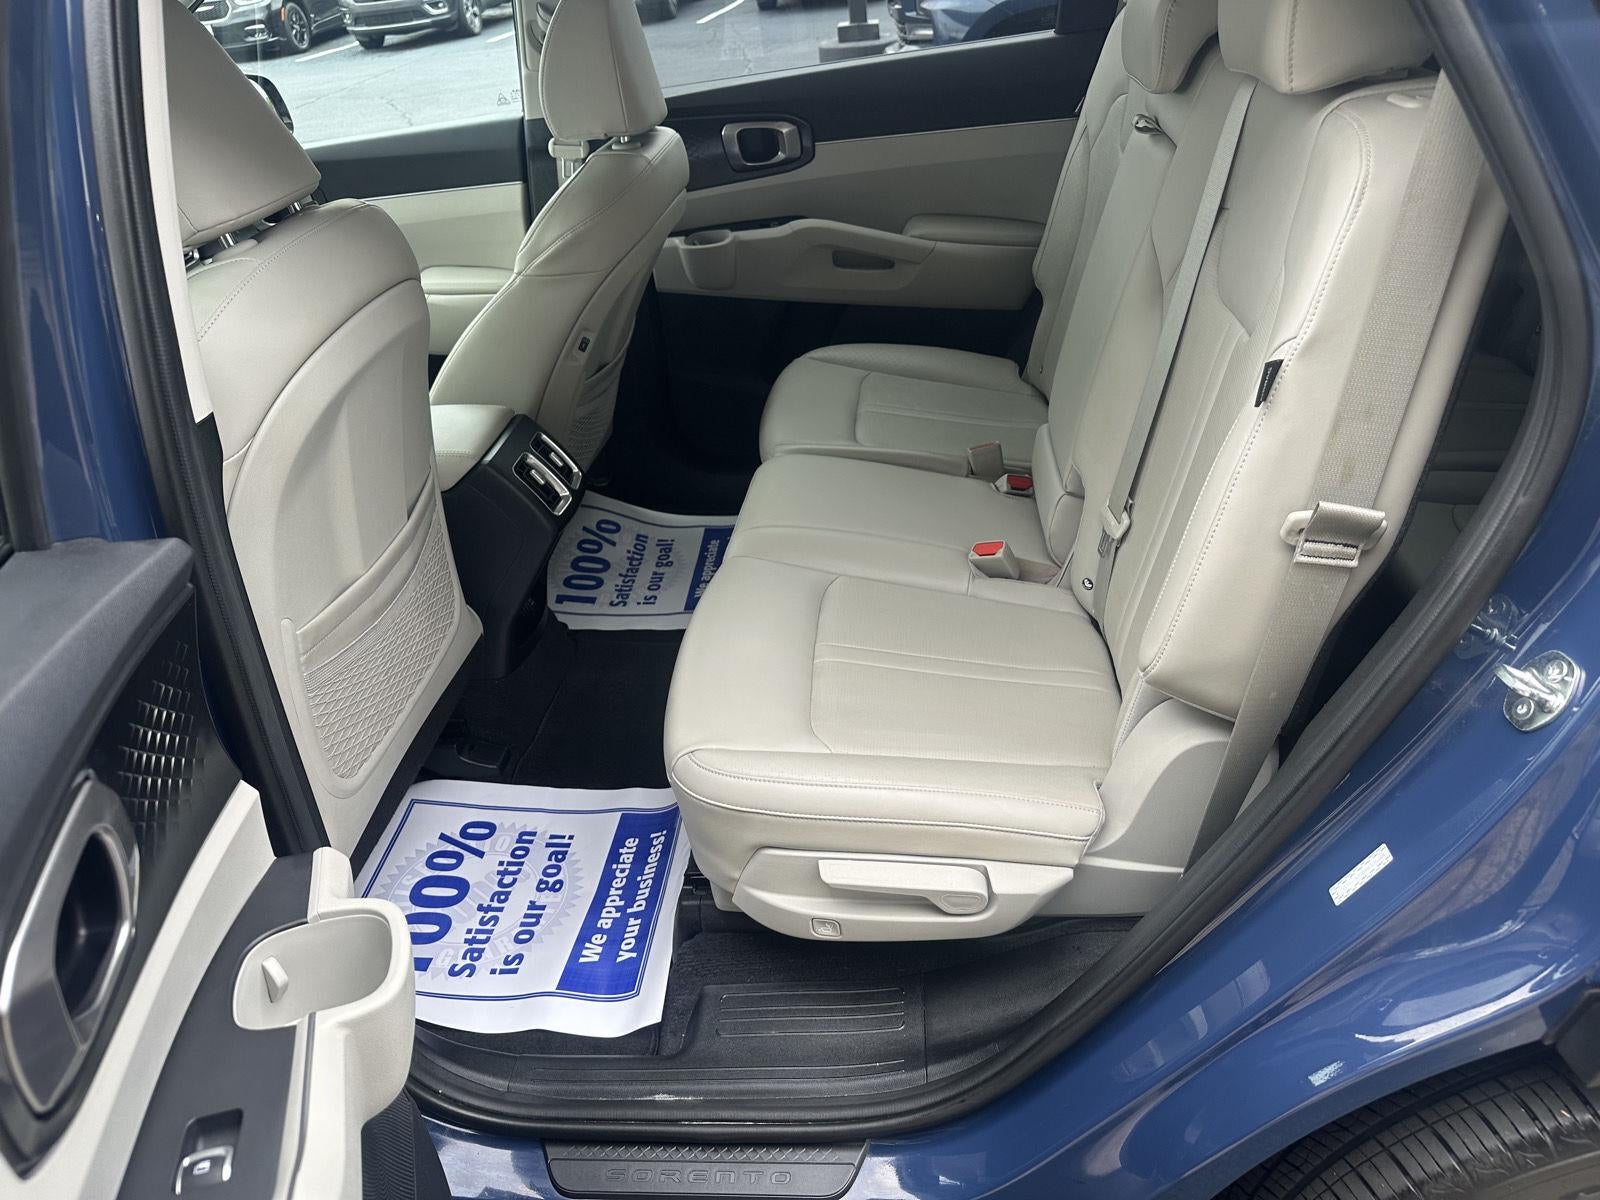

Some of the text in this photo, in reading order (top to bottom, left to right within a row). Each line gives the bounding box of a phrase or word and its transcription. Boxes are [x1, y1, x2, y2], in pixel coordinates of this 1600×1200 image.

[555, 519, 621, 605] 100%
[609, 533, 649, 607] Satisfaction
[636, 538, 675, 605] is our goal!
[701, 539, 719, 581] appreciate
[407, 820, 498, 972] 00%
[448, 830, 538, 979] Satisfaction
[489, 833, 575, 976] is our goal!
[579, 837, 639, 964] We appreciate
[616, 829, 667, 963] your business!
[606, 1168, 793, 1185] SORENTO
